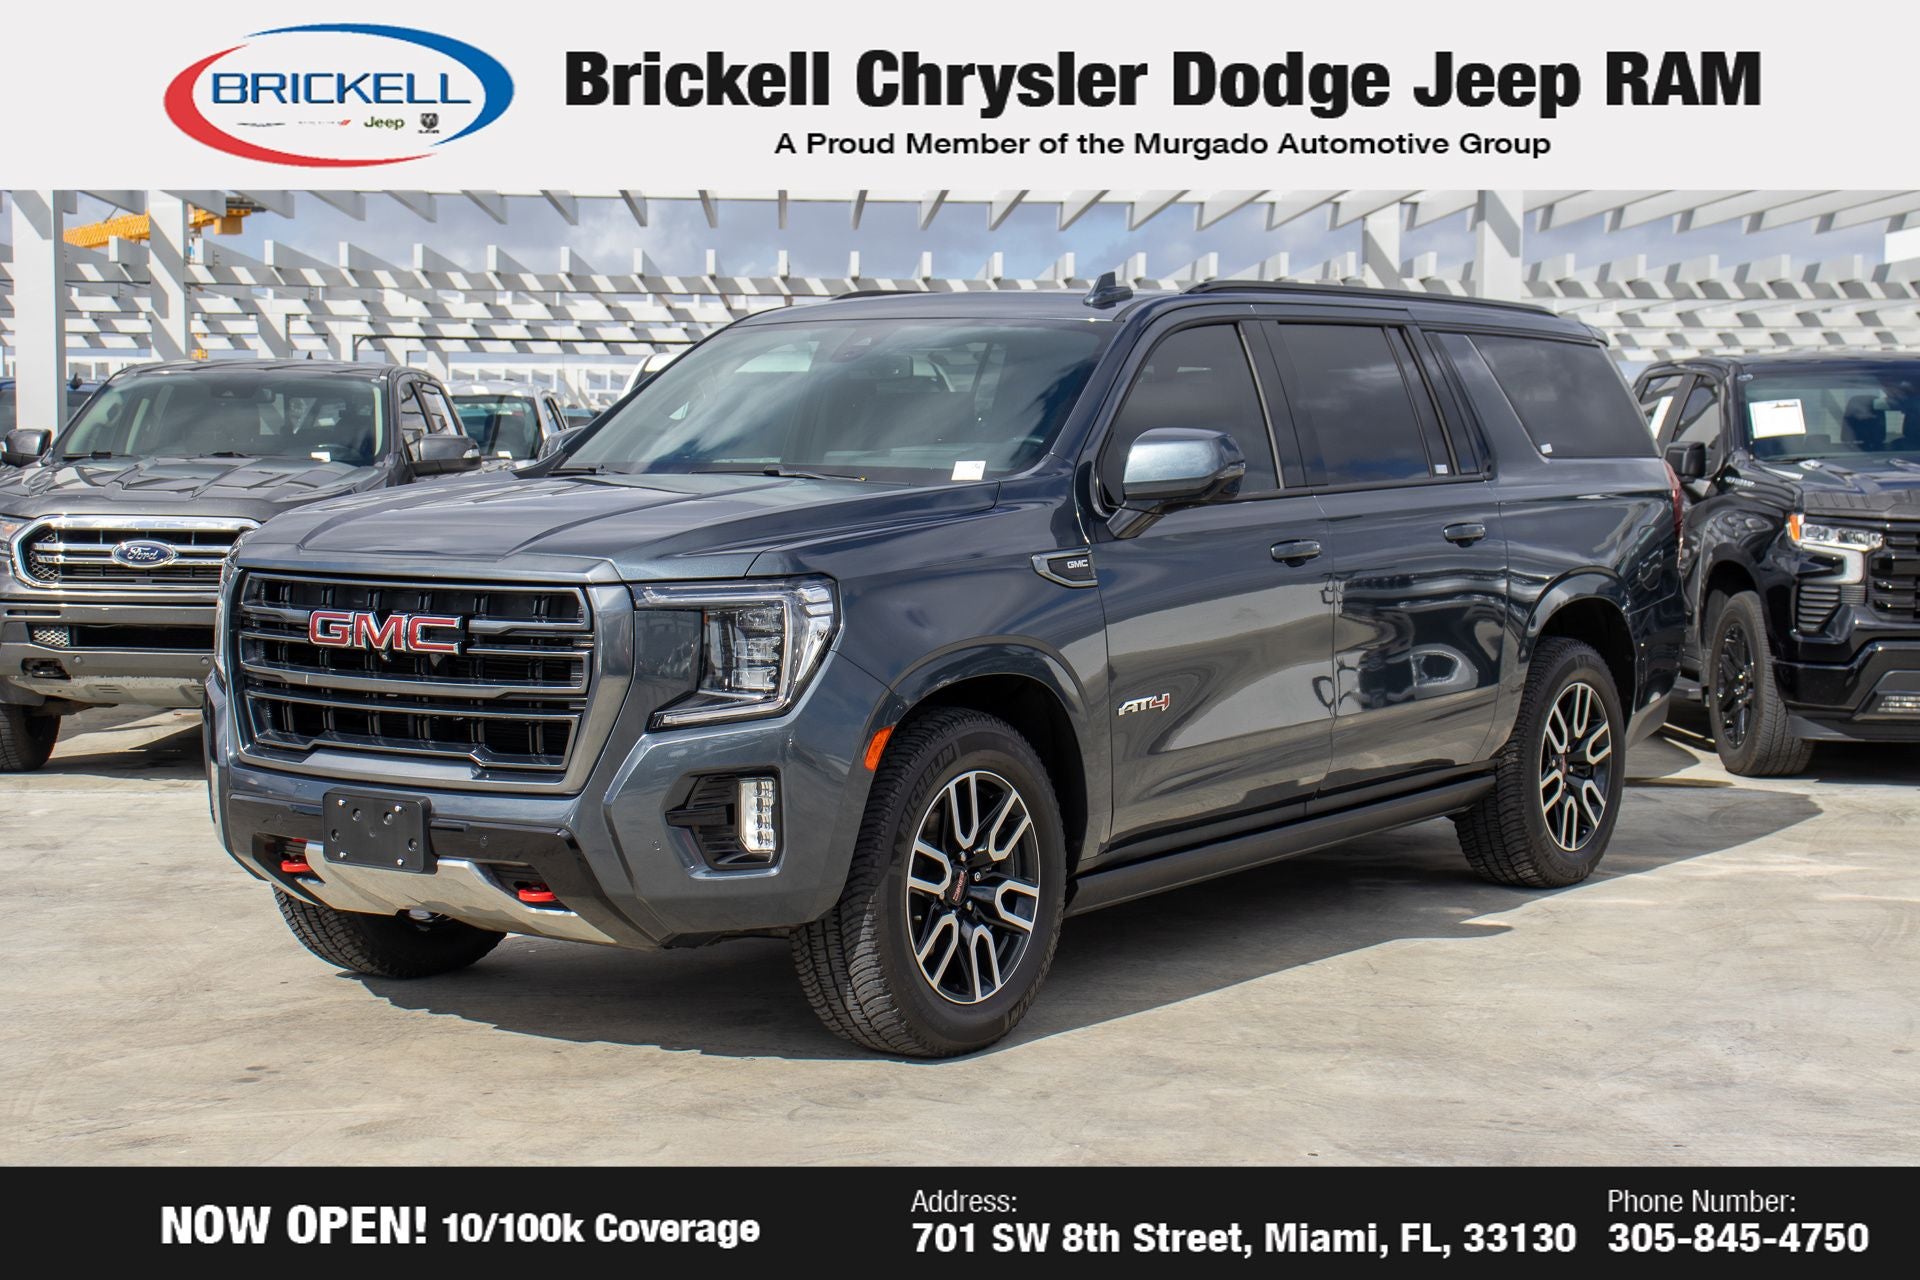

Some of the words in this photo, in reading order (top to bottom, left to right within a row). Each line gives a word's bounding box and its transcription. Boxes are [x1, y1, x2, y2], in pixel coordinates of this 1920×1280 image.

[127, 546, 159, 560] Ford
[1067, 559, 1089, 569] GMC
[308, 610, 463, 655] GMC
[1118, 693, 1170, 716] AT4
